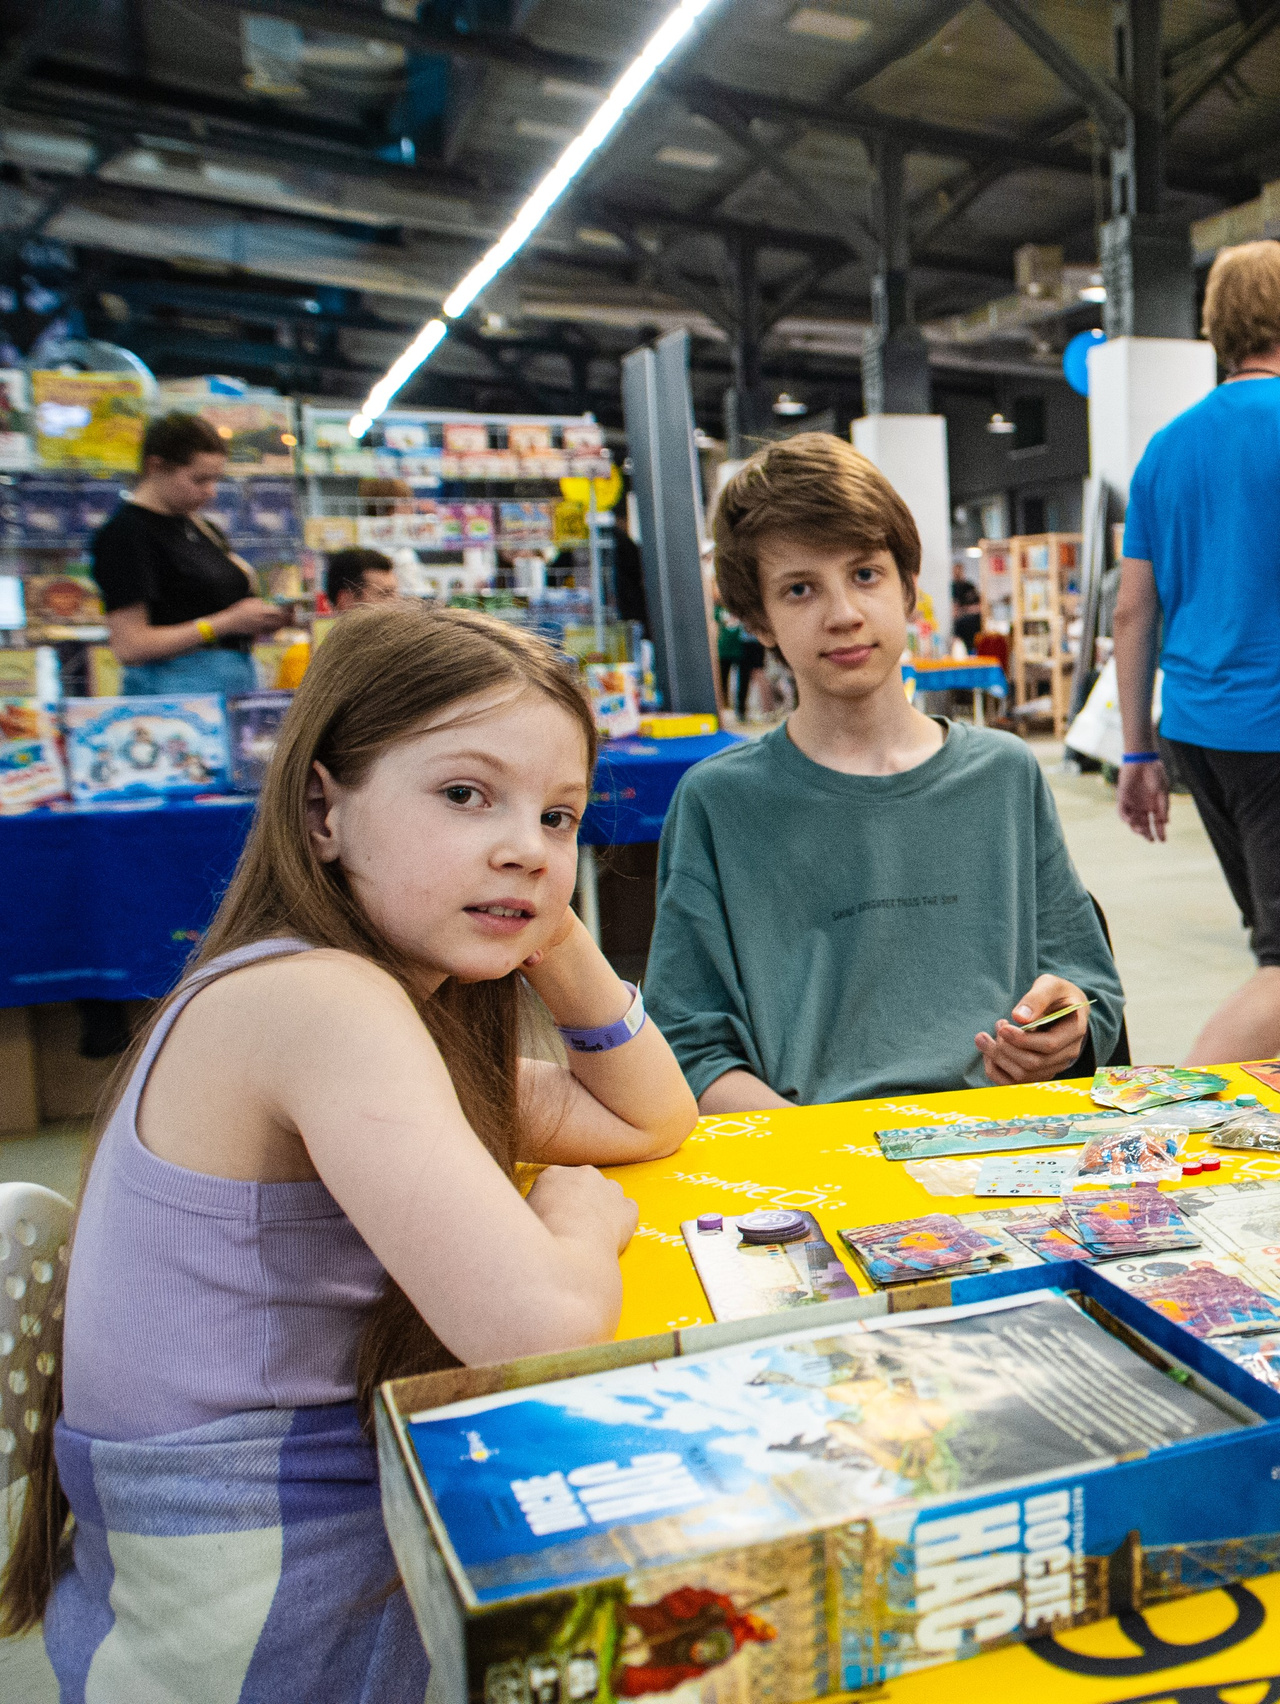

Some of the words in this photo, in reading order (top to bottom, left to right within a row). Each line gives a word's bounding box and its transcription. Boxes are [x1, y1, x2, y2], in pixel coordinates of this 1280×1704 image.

[671, 1170, 787, 1200] Эврикус
[915, 1500, 1024, 1651] НАС
[1024, 1489, 1071, 1629] ПОСЛЕ
